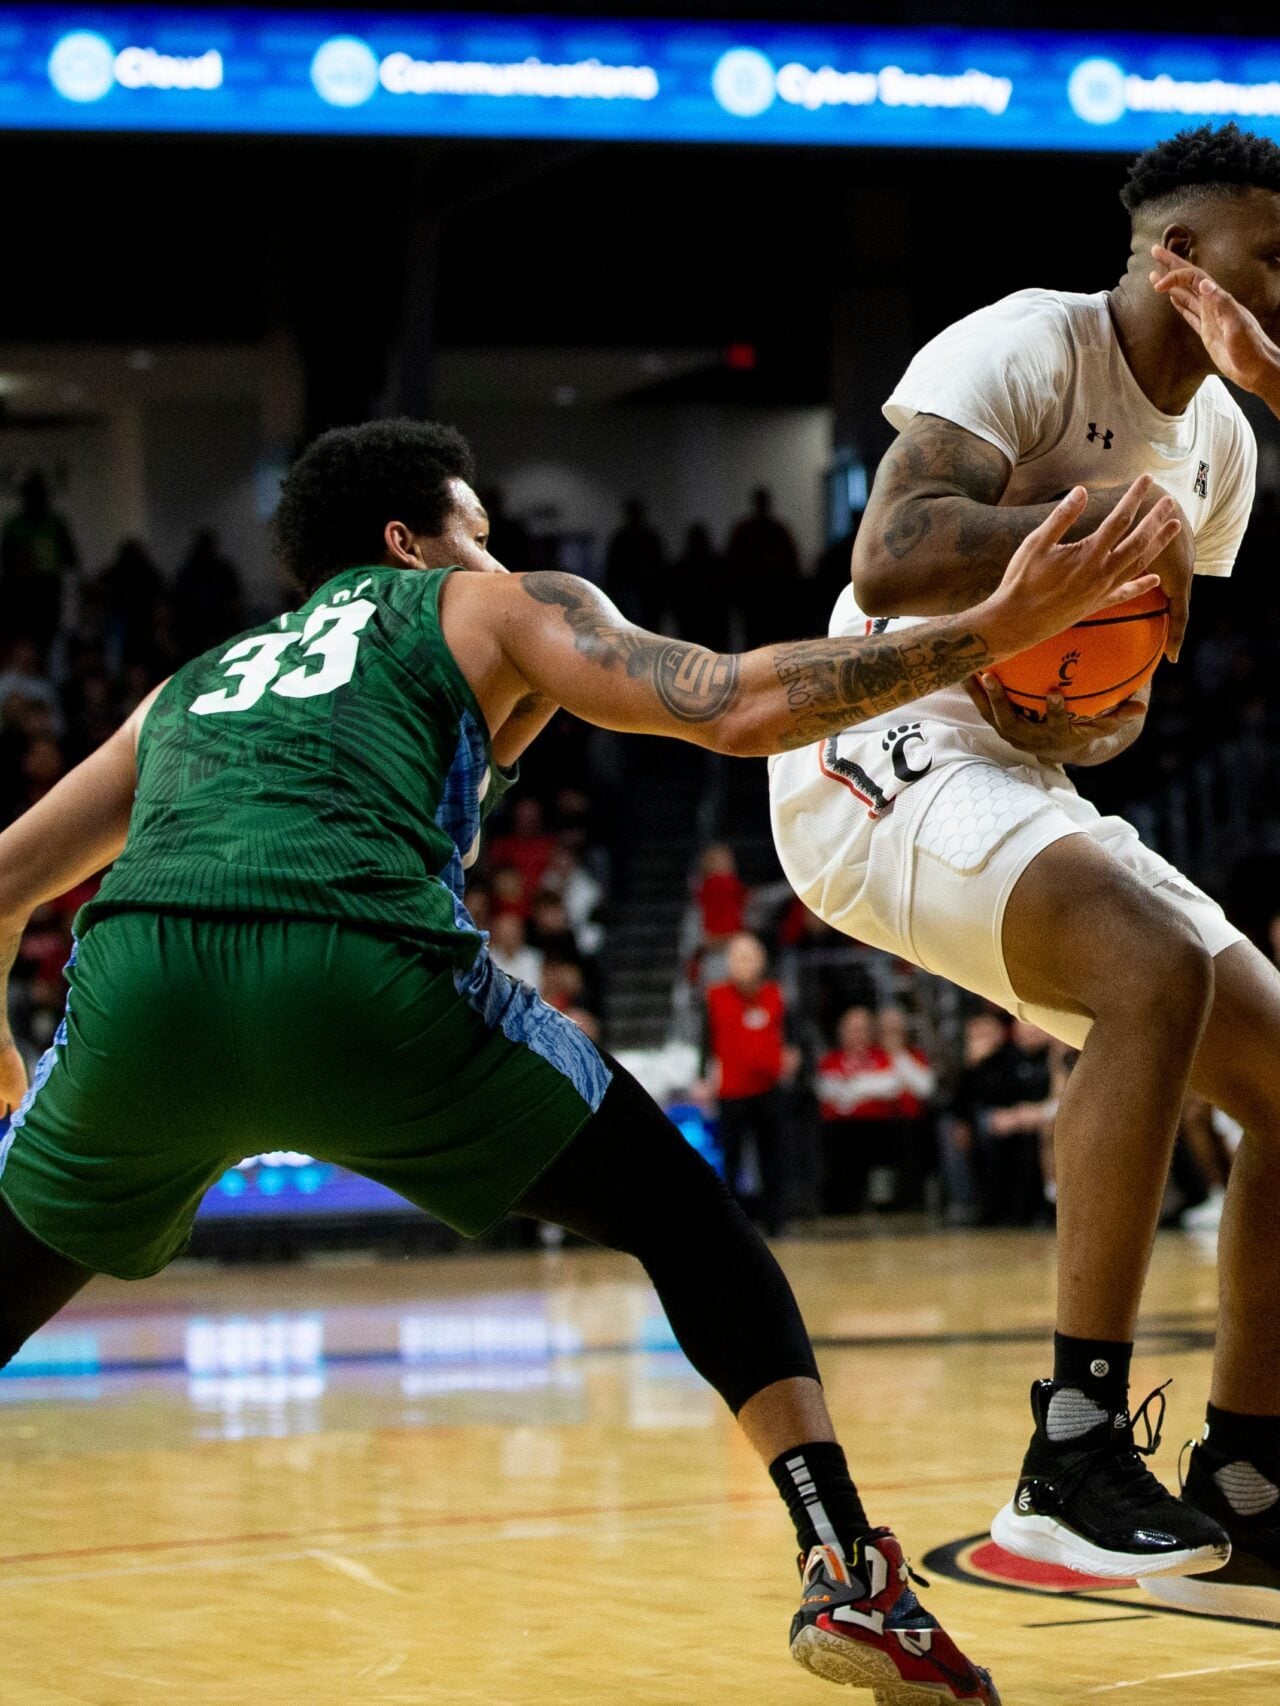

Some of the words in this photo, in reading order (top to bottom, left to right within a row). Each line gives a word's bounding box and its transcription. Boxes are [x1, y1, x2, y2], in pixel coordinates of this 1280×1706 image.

[115, 49, 221, 89] Cloud
[380, 54, 657, 98] Communications
[777, 64, 877, 109] Cyber
[879, 68, 1010, 112] Security
[188, 598, 377, 716] 33
